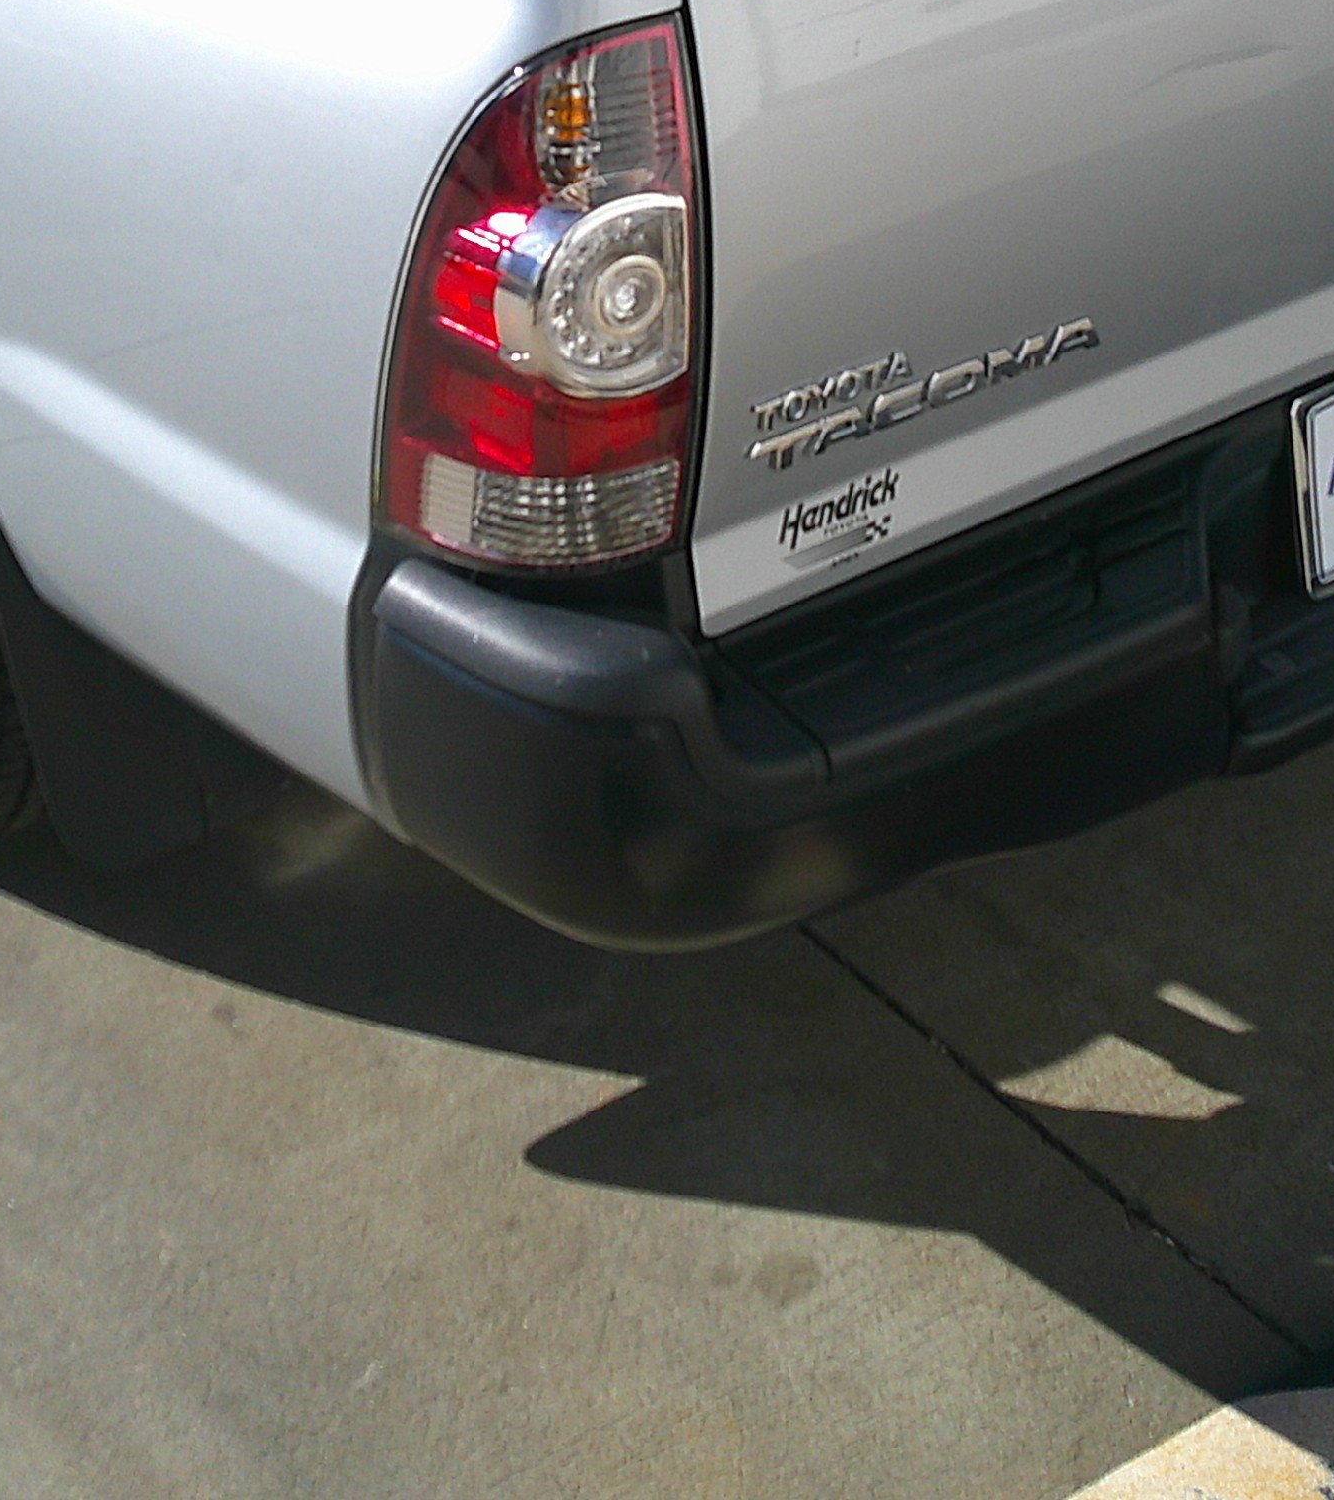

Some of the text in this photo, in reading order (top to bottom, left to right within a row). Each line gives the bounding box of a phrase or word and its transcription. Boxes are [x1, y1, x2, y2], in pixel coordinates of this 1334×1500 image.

[747, 316, 1101, 471] TACOMA
[750, 351, 914, 431] TOYOTA
[779, 468, 899, 550] Hendrick
